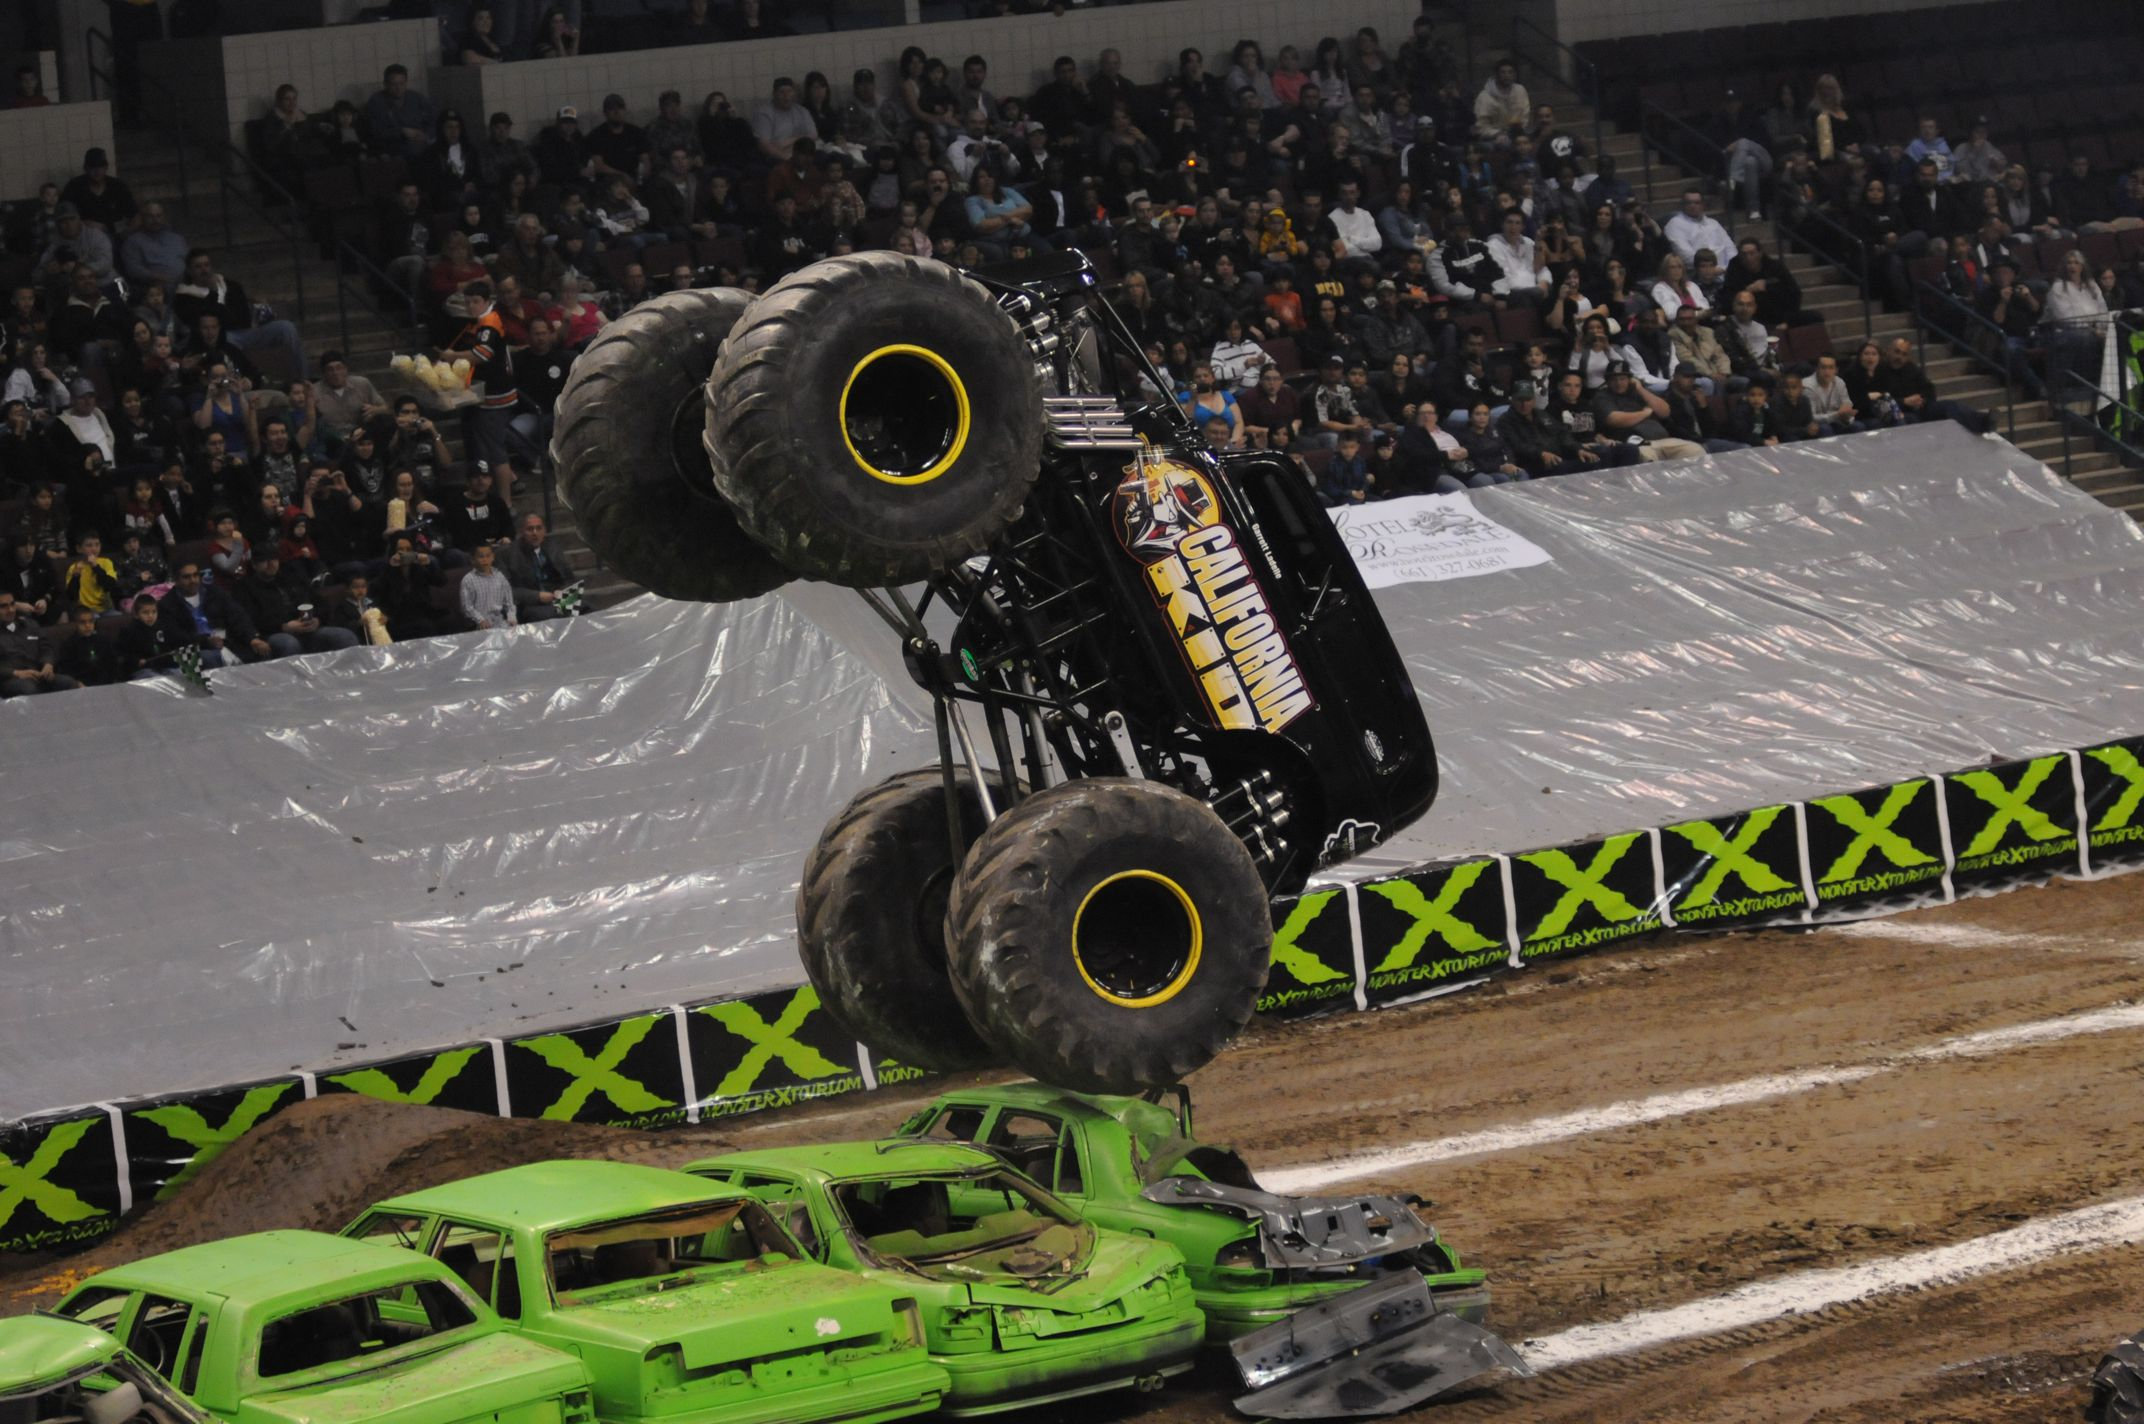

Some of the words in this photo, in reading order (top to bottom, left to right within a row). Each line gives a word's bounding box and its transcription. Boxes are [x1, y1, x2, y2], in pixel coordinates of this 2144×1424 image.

[1252, 523, 1270, 552] Garrett
[1147, 555, 1256, 731] KID
[1179, 527, 1313, 733] CALIFORNIA
